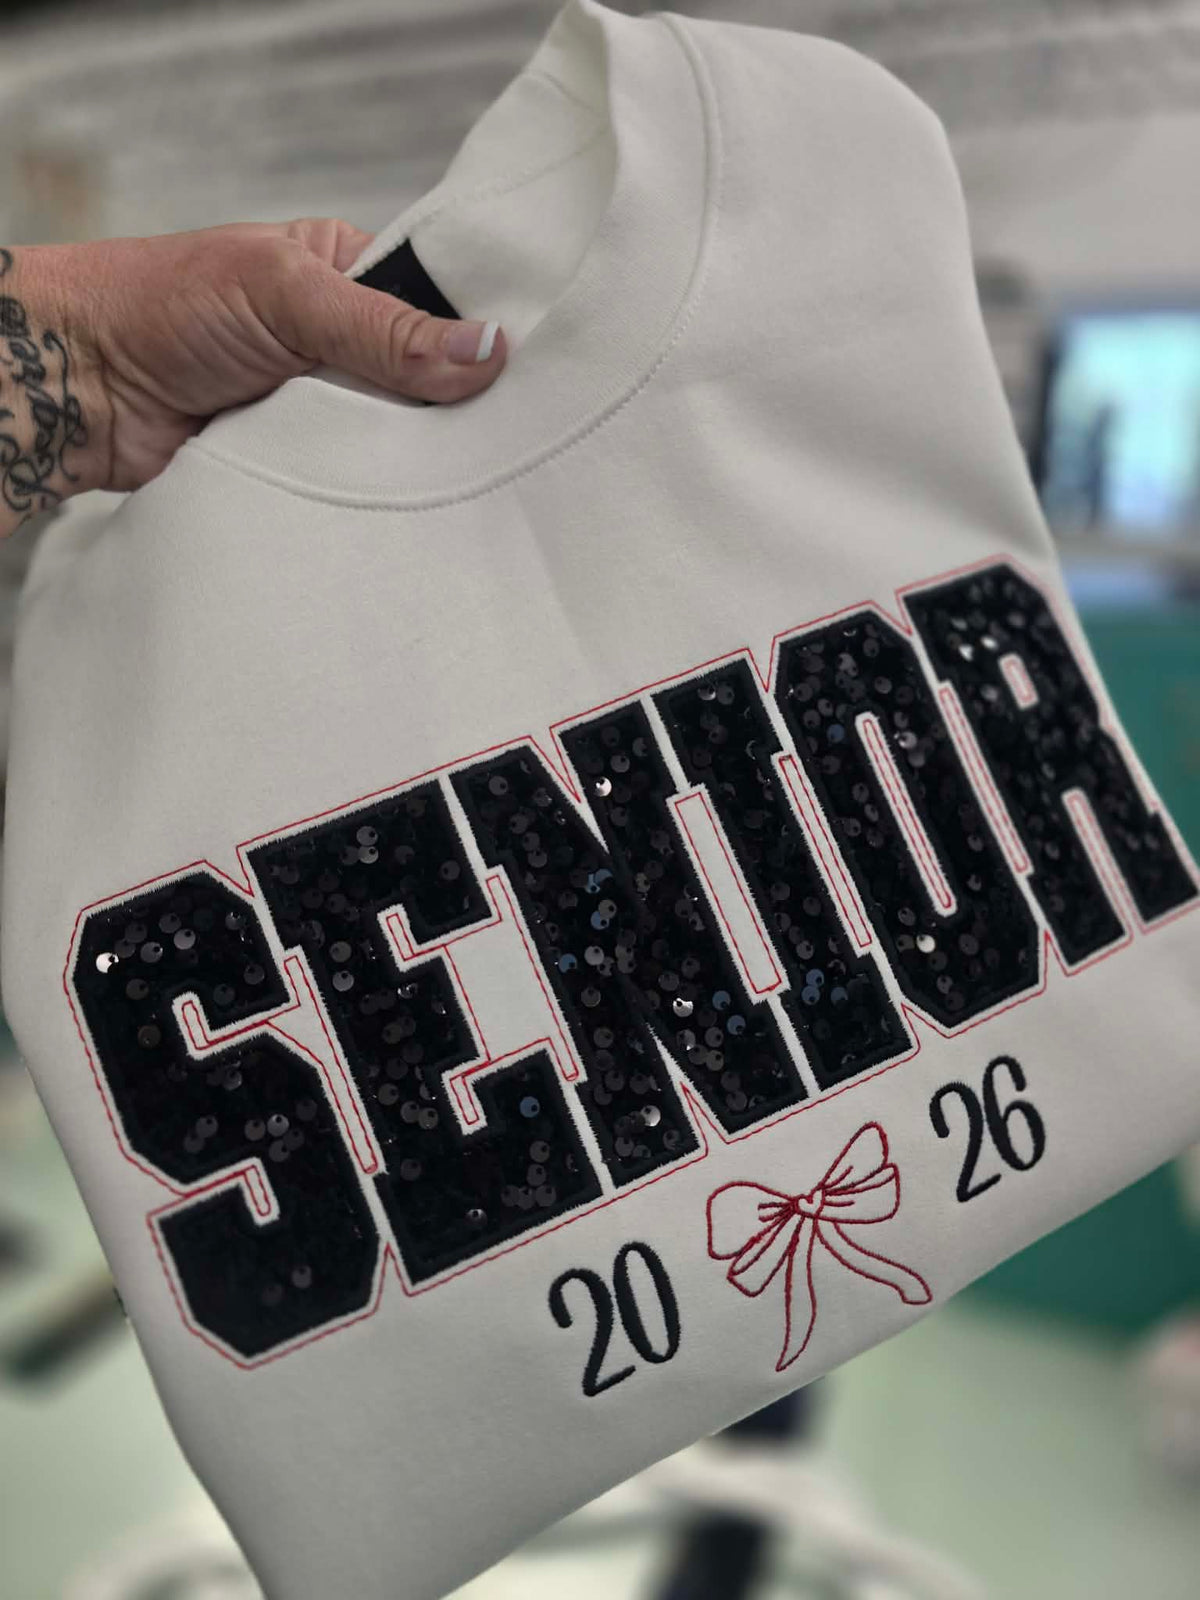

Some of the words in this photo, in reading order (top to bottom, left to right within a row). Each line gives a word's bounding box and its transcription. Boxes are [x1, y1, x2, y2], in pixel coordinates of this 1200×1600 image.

[68, 558, 1200, 1365] SENIOR
[548, 1241, 680, 1397] 20
[929, 1055, 1047, 1203] 26
